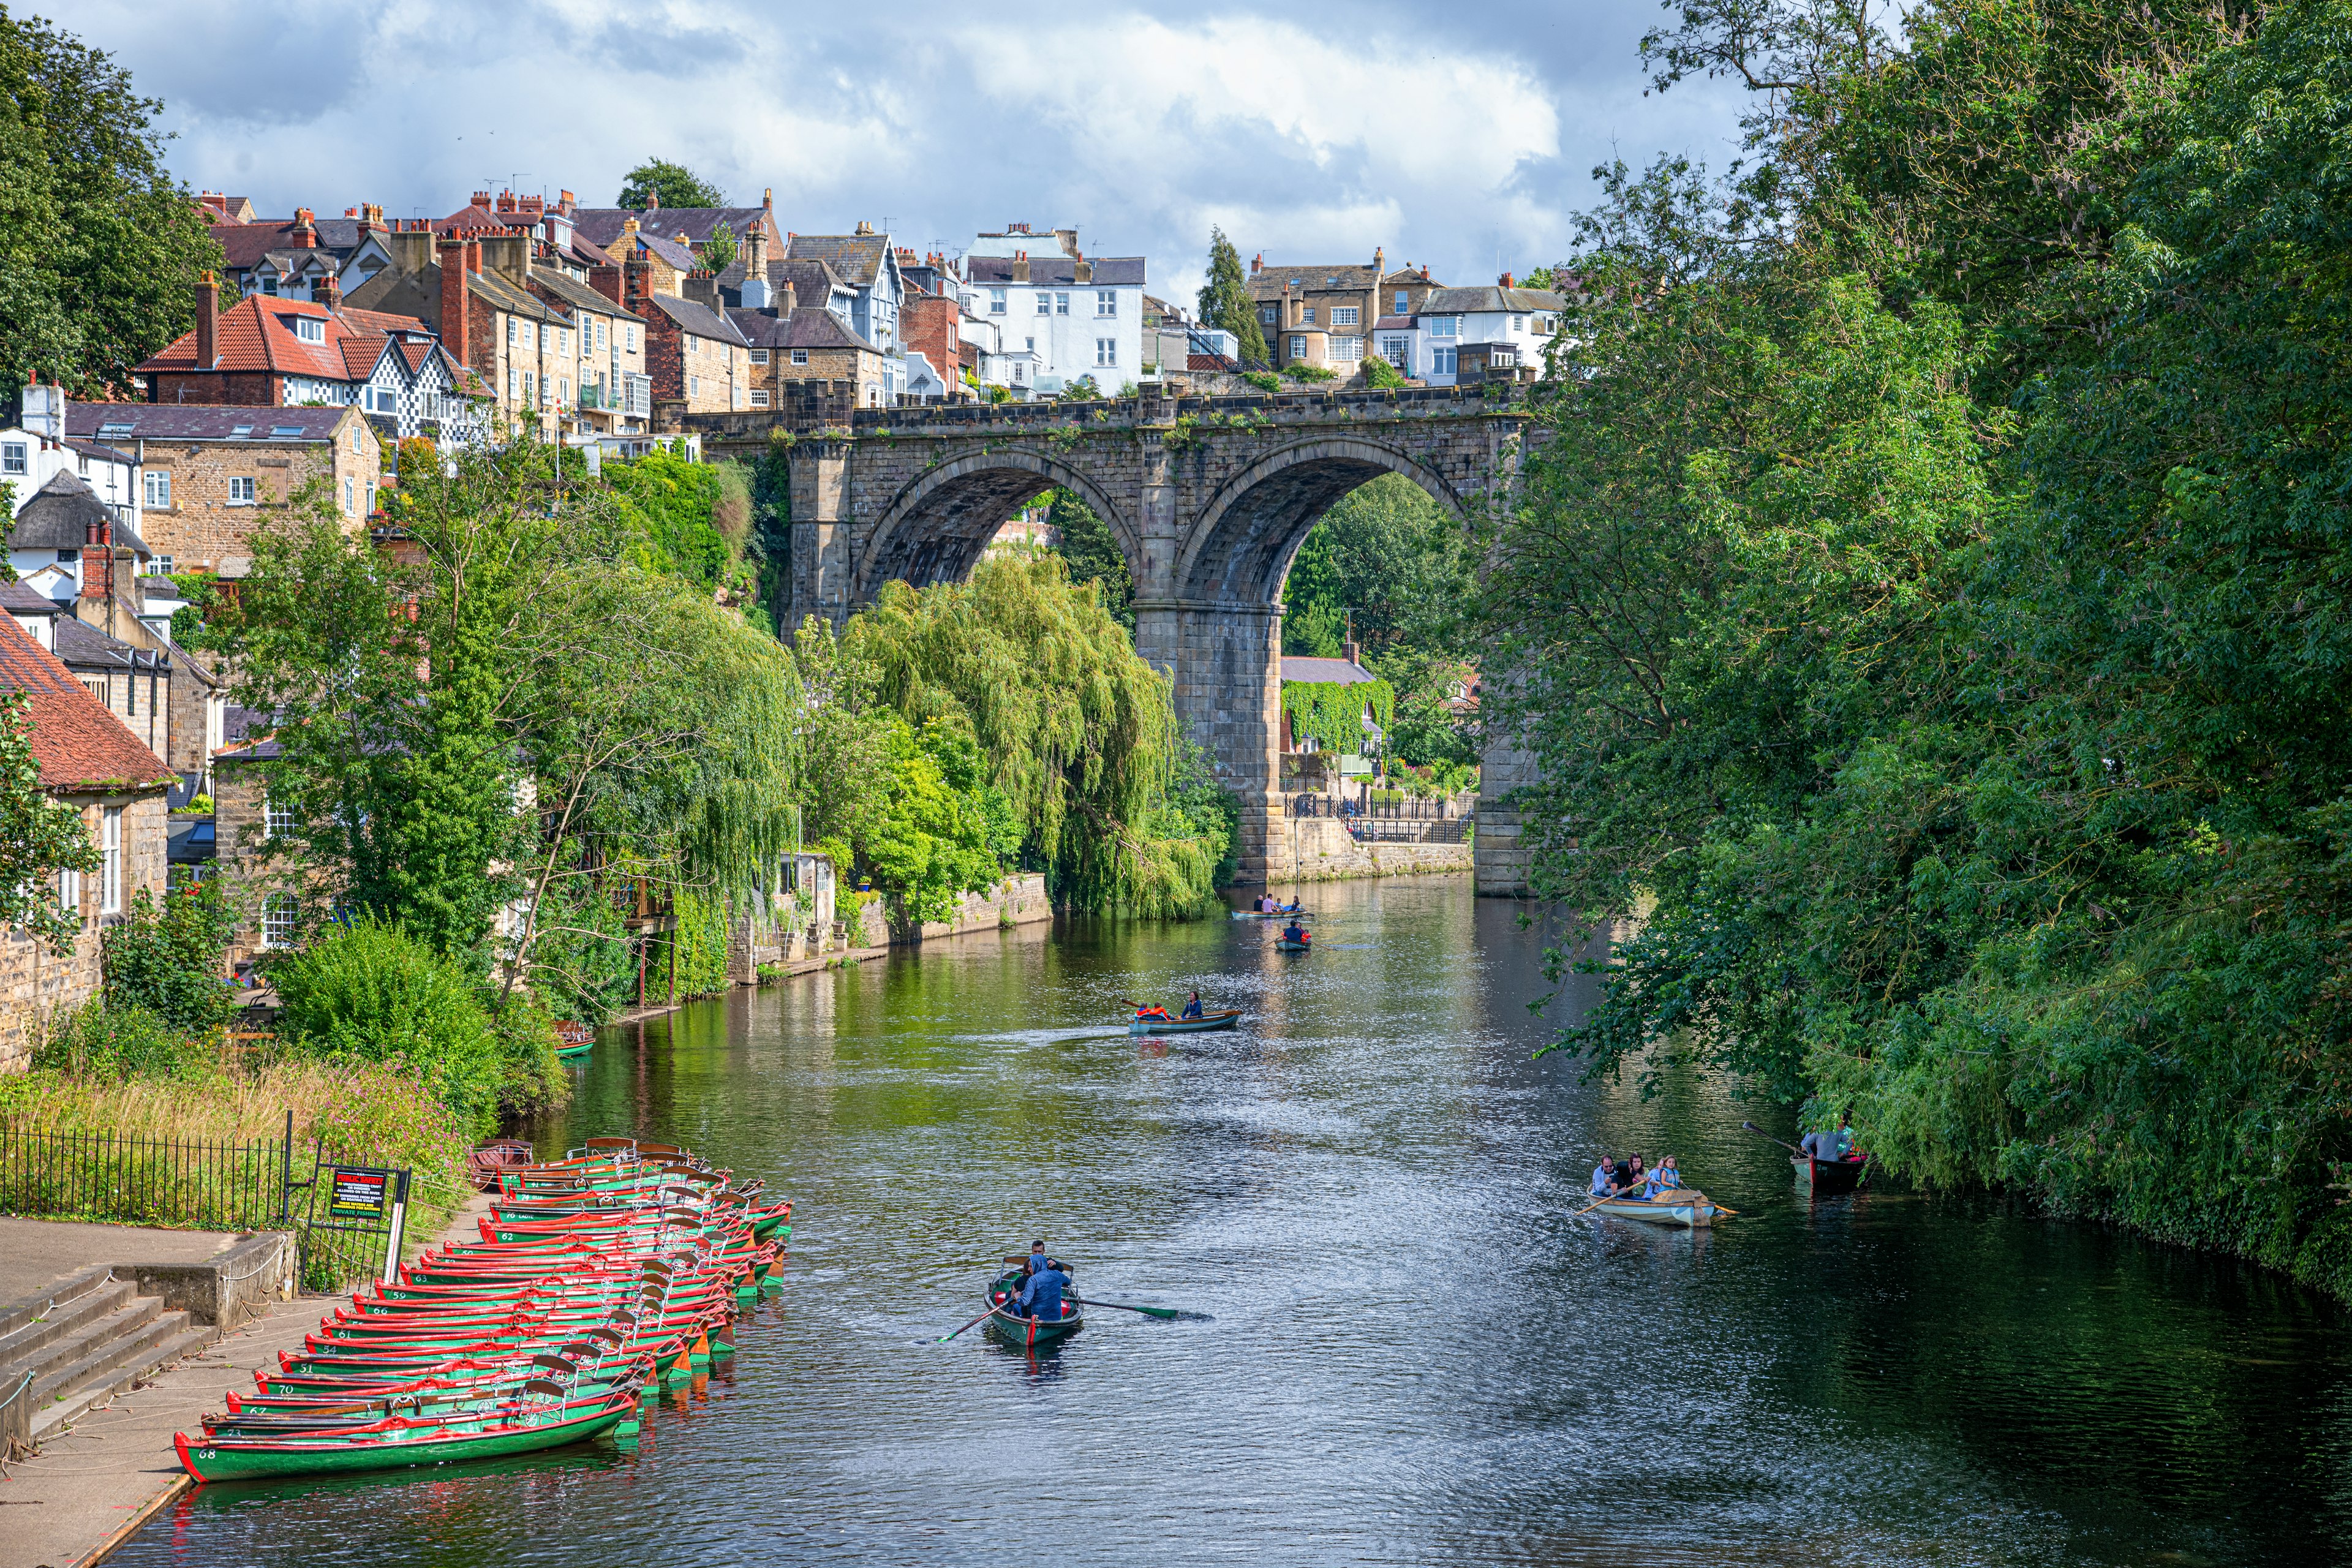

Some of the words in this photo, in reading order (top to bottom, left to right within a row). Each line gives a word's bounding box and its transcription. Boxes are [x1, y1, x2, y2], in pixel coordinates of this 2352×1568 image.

[337, 1174, 359, 1183] PUBLIC
[393, 1291, 406, 1300] 59
[339, 1330, 352, 1339] 61
[323, 1345, 337, 1355] 54
[300, 1363, 313, 1373] 51
[279, 1385, 293, 1394] 70
[198, 1449, 216, 1459] 68
